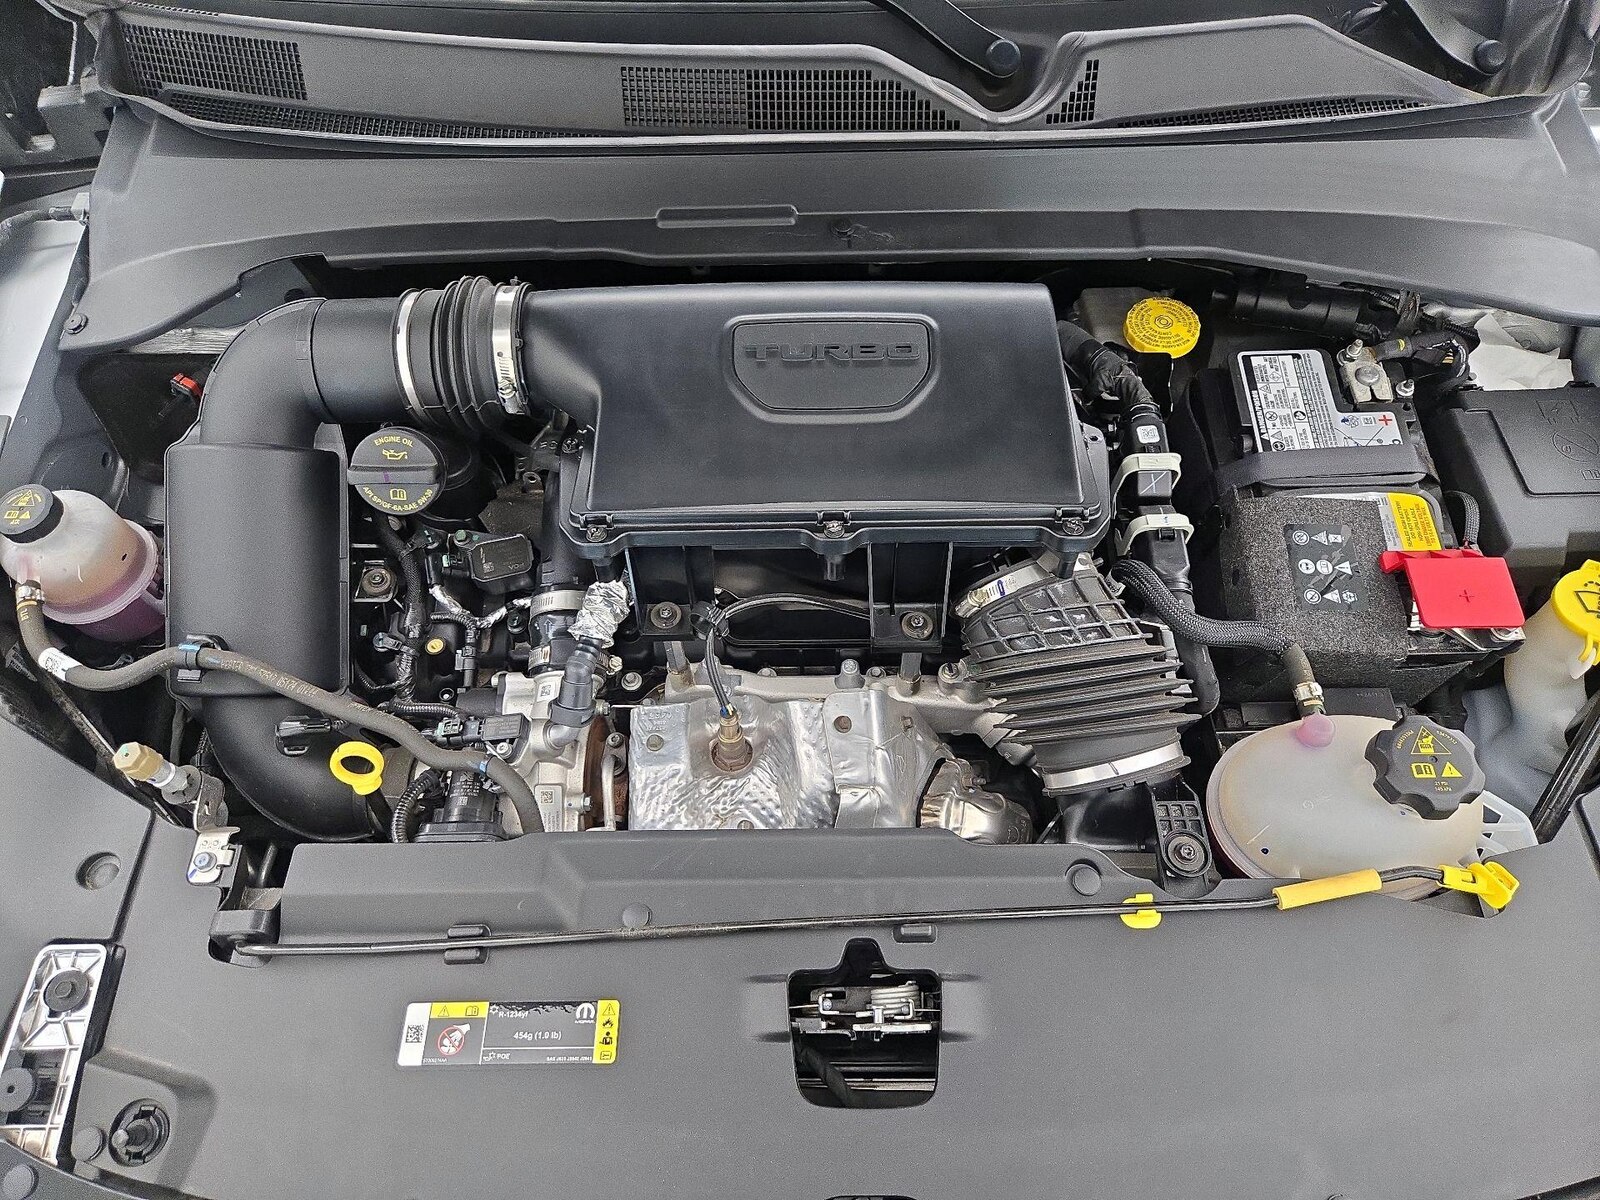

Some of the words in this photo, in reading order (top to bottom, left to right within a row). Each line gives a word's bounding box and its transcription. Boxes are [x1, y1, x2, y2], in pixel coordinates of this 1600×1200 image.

[746, 342, 920, 362] TURBO
[374, 436, 401, 446] ENGINE
[402, 438, 414, 448] OIL
[363, 486, 372, 498] API
[498, 1010, 529, 1019] R-1234yf
[513, 1032, 534, 1041] 454g
[534, 1031, 550, 1040] (1.0
[551, 1031, 562, 1040] lb)
